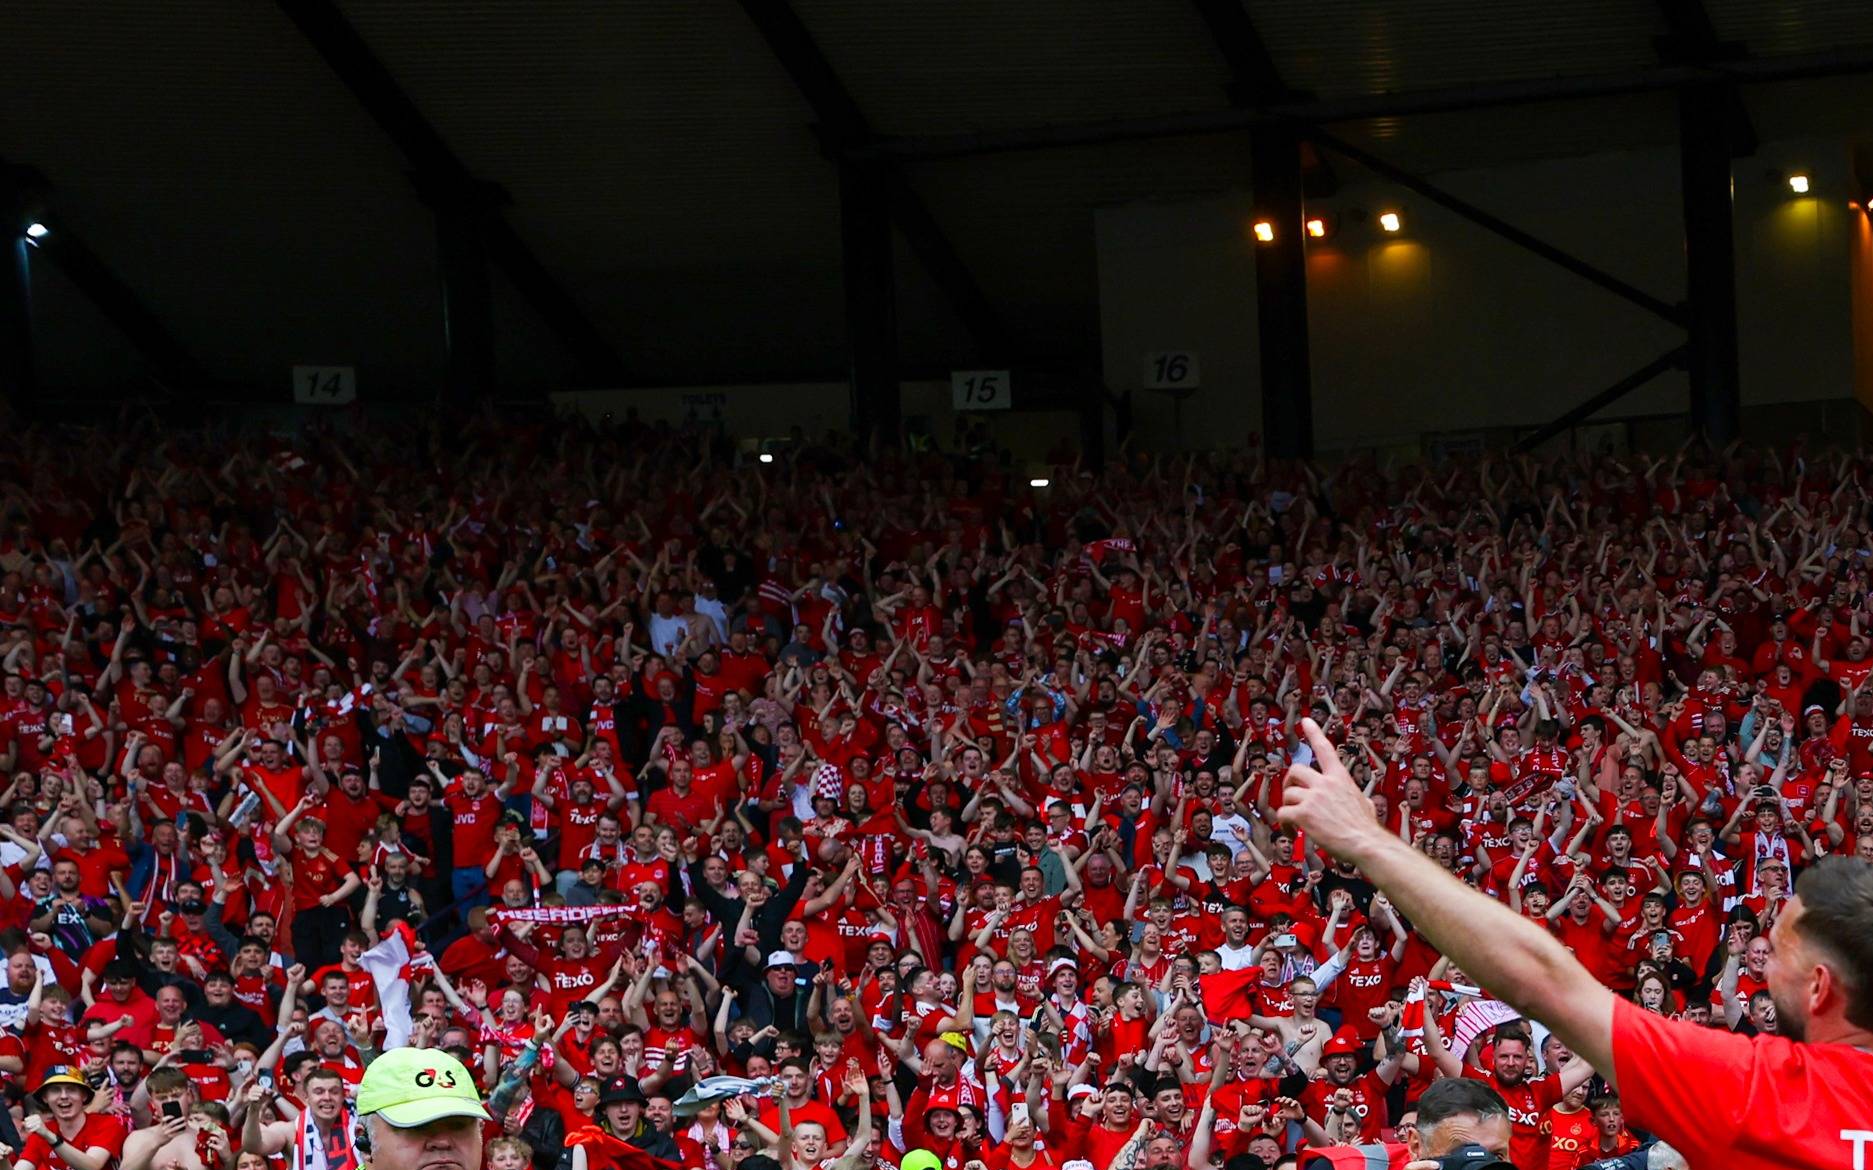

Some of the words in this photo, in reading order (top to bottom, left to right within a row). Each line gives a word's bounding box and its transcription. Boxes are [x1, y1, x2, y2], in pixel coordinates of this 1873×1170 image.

[1156, 354, 1189, 382] 16
[307, 372, 341, 398] 14
[965, 377, 998, 403] 15
[454, 814, 476, 824] JVC
[570, 811, 596, 825] TEXO
[1482, 838, 1510, 848] TEXO
[497, 904, 637, 924] ABERDEEN
[1202, 902, 1224, 914] TEX
[554, 974, 594, 990] TEXO
[1018, 975, 1039, 985] TEXO
[1348, 974, 1381, 987] TEXO
[1508, 1106, 1540, 1127] EXO
